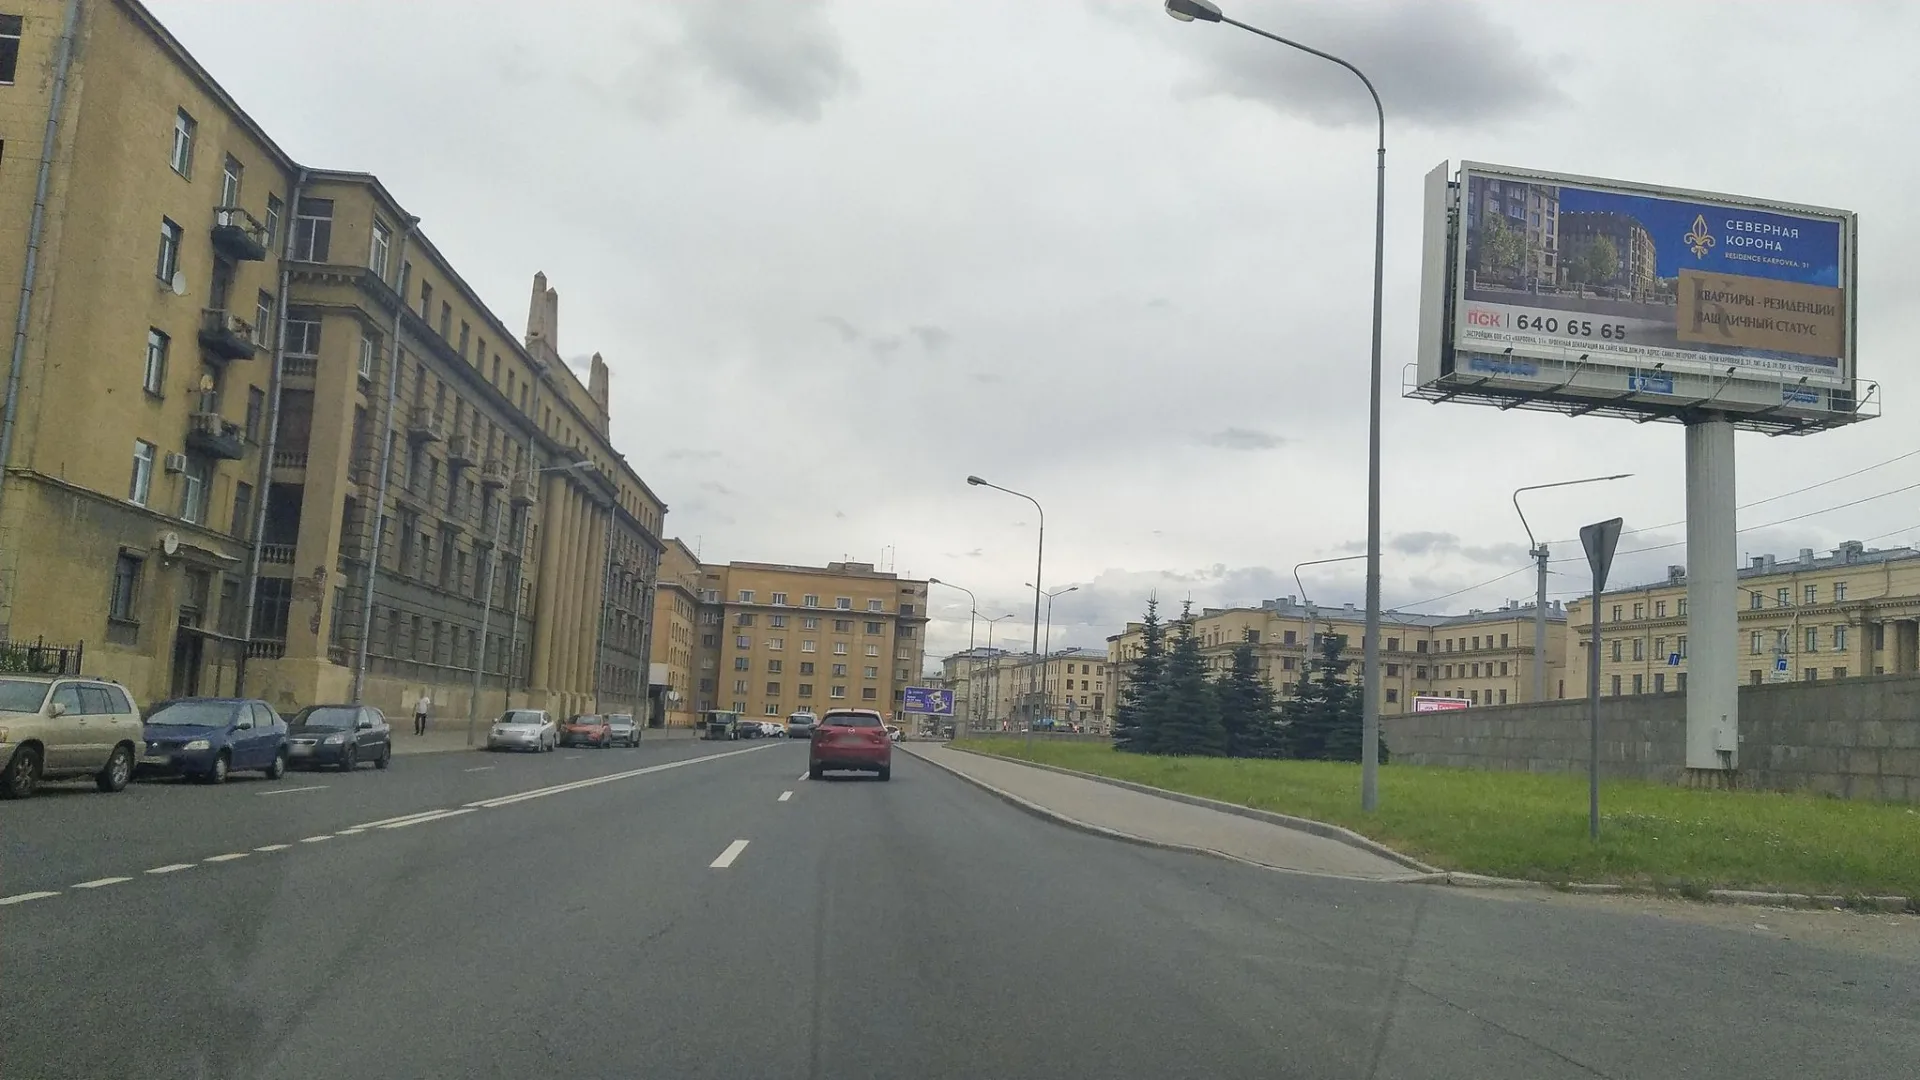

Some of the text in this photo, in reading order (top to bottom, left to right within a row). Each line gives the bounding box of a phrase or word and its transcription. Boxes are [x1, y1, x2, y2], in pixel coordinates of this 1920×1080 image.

[1725, 219, 1799, 239] СЕВЕРНАЯ
[1725, 235, 1783, 252] КОРОНА
[1725, 251, 1761, 263] RESIDENCE
[1699, 289, 1755, 307] КВАРТИРЫ
[1763, 297, 1835, 316] РЕЗИДЕНЦИИ
[1467, 310, 1501, 328] ПСК
[1516, 314, 1626, 340] 640 65 65
[1724, 313, 1773, 330] ЛИЧНЫЙ
[1775, 320, 1817, 336] СТАТУС
